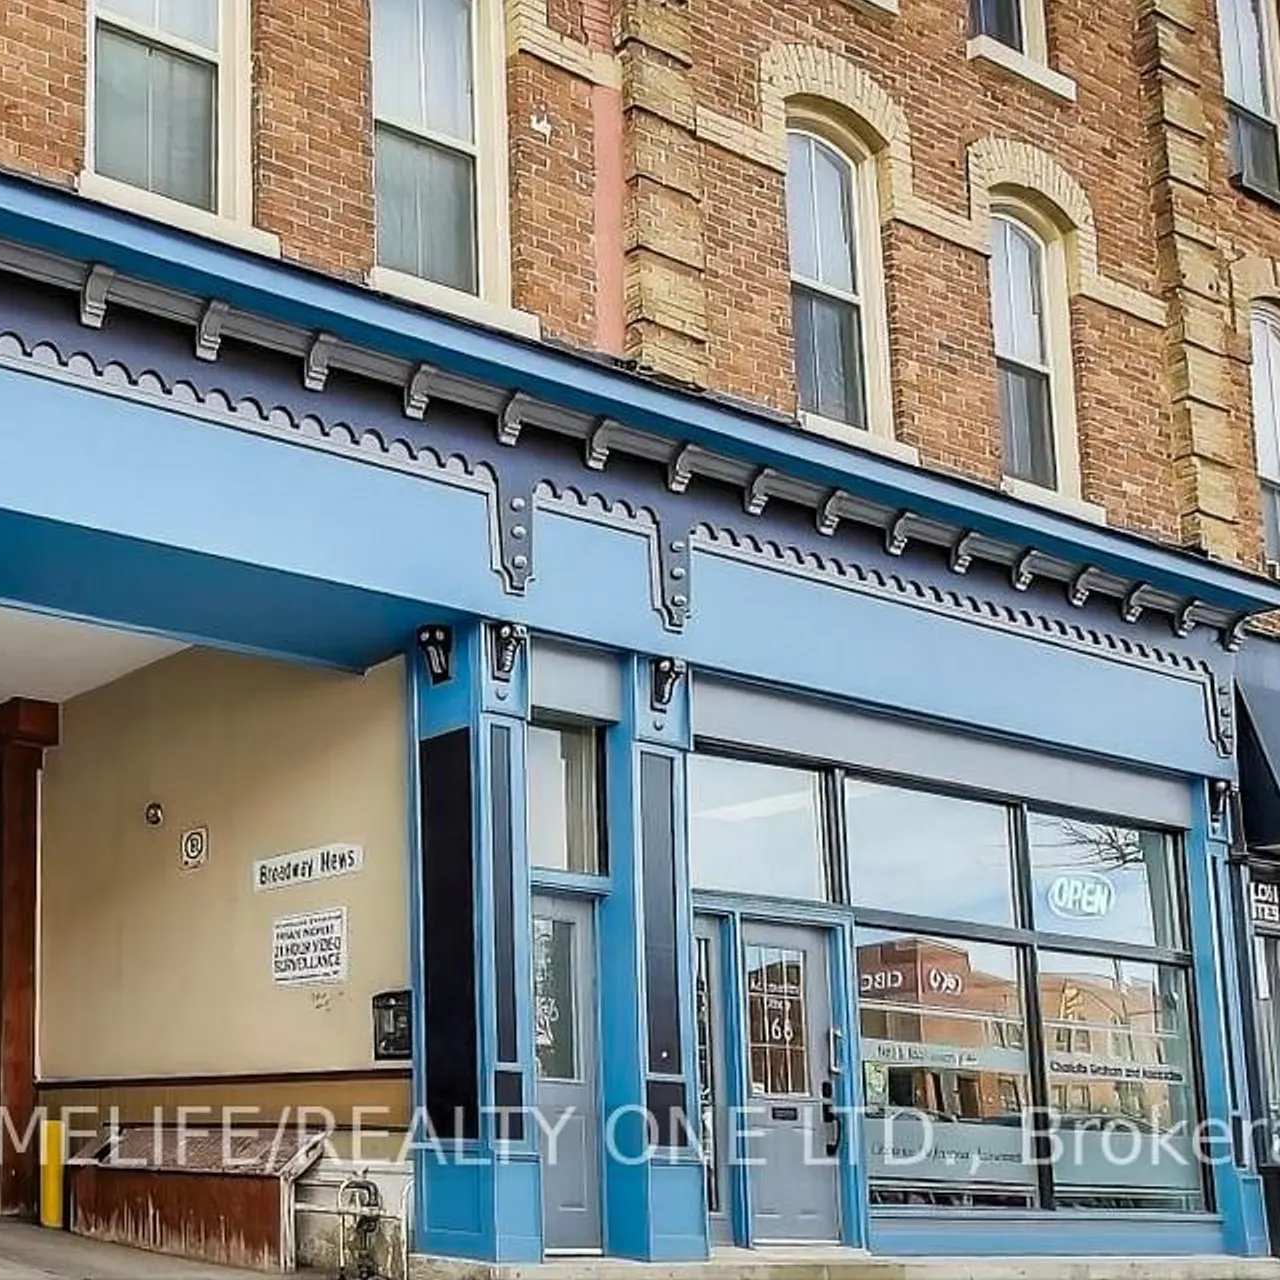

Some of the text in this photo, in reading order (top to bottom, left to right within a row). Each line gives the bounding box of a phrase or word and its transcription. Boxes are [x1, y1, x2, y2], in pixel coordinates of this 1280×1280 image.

[259, 849, 355, 885] Broadway News
[1053, 876, 1109, 916] OPEN
